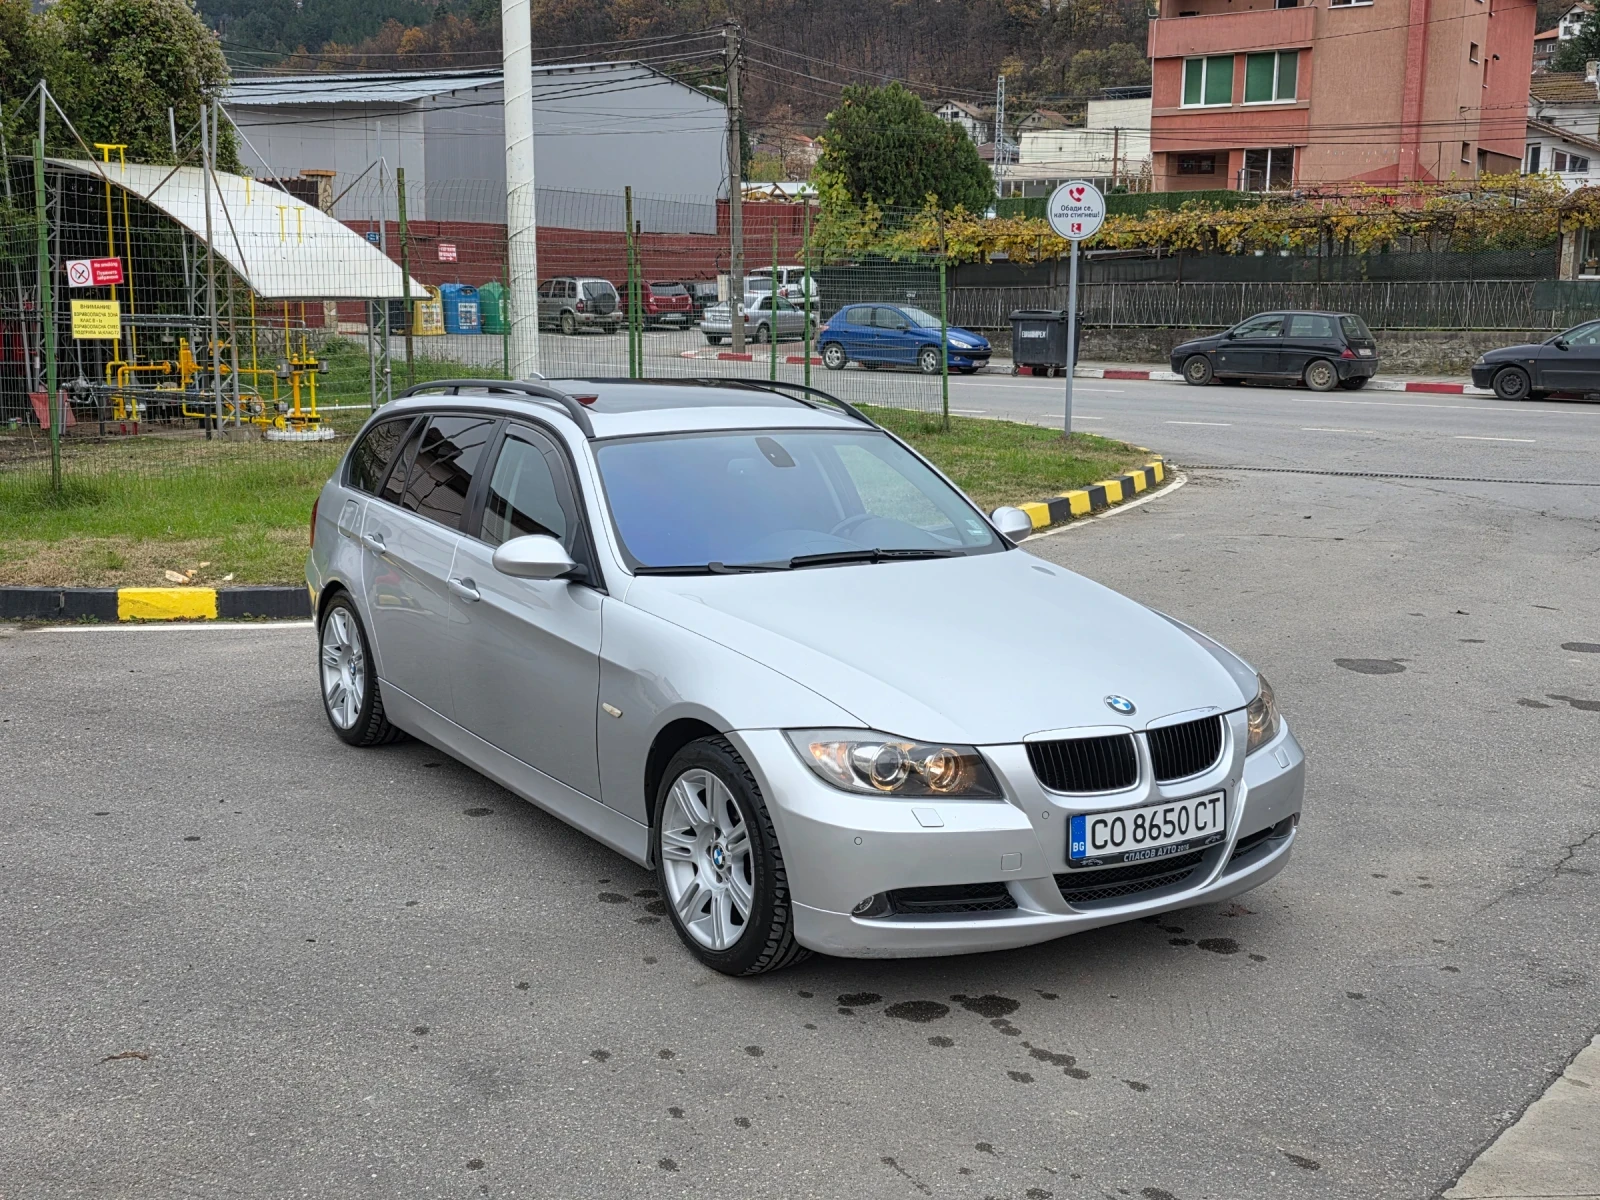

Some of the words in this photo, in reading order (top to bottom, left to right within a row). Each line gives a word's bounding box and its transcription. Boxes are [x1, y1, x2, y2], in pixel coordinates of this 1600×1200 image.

[1091, 816, 1127, 850] CO
[1132, 805, 1190, 844] 8650
[1194, 797, 1221, 832] CT
[1072, 841, 1085, 852] BG
[1123, 847, 1155, 862] СПАСОВ
[1157, 845, 1177, 856] АУТО
